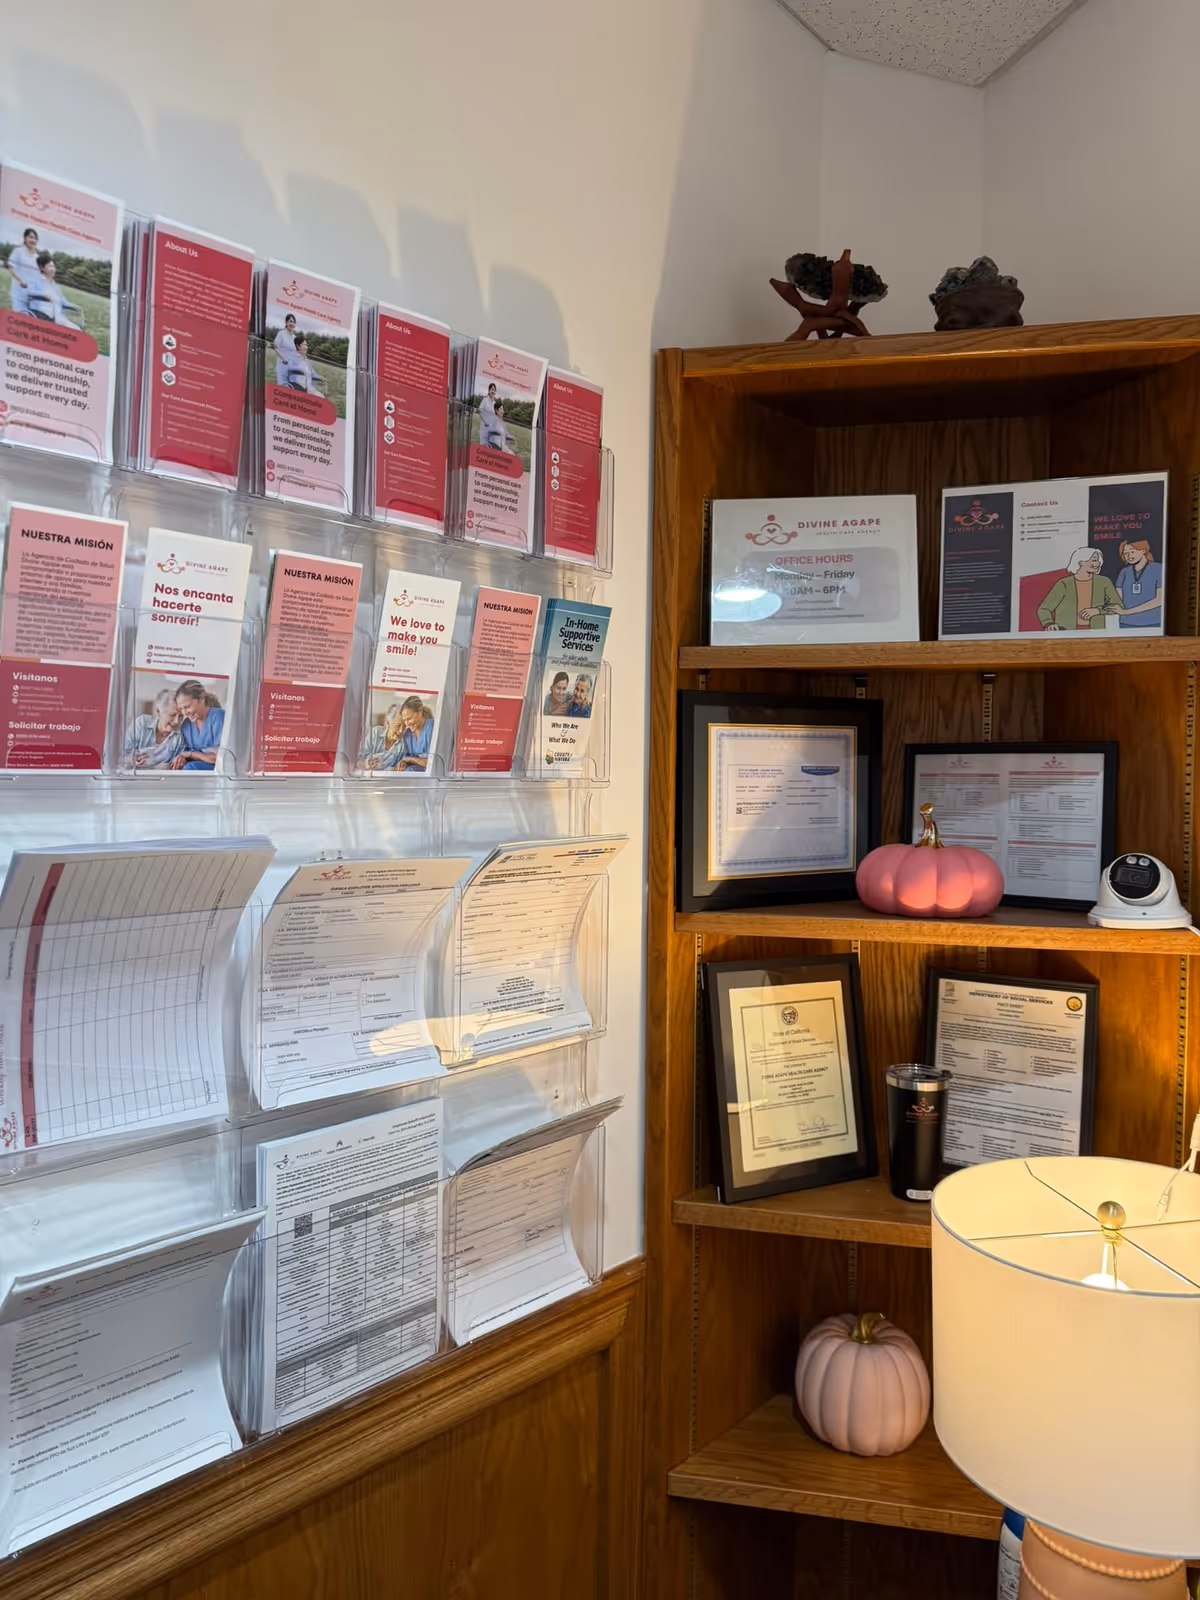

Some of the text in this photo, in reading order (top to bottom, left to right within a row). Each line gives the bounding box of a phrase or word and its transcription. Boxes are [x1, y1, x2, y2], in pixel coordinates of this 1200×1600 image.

[165, 240, 198, 258] About Us
[386, 321, 402, 332] About
[8, 328, 28, 340] Care
[42, 338, 68, 350] Home
[6, 346, 94, 377] From personal care
[6, 360, 90, 388] to companionship,
[6, 372, 88, 398] we deliver trusted
[553, 383, 566, 392] About
[5, 382, 90, 410] support every day.
[273, 398, 289, 408] Care
[298, 406, 316, 416] Home
[274, 414, 334, 438] From personal care
[282, 428, 332, 448] companionship,
[284, 436, 306, 448] deliver
[308, 444, 330, 456] trusted
[273, 444, 332, 466] support every day.
[475, 470, 488, 479] From
[489, 475, 510, 486] personal
[481, 482, 520, 498] companionship,
[482, 490, 499, 499] deliver
[500, 495, 518, 504] trusted
[474, 497, 494, 507] support
[494, 502, 508, 511] every
[798, 518, 880, 528] DIVINE AGAPE
[22, 528, 113, 550] NUESTRA MISIÓN
[186, 561, 206, 569] DIVINE
[776, 554, 854, 566] OFFICE HOURS
[284, 568, 354, 586] NUESTRA MISIÓN
[775, 570, 855, 581] Monday Friday
[154, 583, 234, 604] Nos encanta
[823, 586, 846, 594] 6PM
[152, 597, 202, 612] hacerte
[484, 602, 512, 612] NUESTRA
[152, 613, 200, 626] sonreír!
[390, 616, 444, 632] We love to
[565, 617, 599, 632] In-Home
[388, 632, 438, 645] make you
[559, 628, 600, 642] Supportive
[386, 644, 418, 656] smile!
[562, 639, 594, 652] Services
[13, 672, 58, 682] Visitanos
[270, 692, 304, 701] Visitanos
[8, 722, 81, 732] Solicitar trabajo
